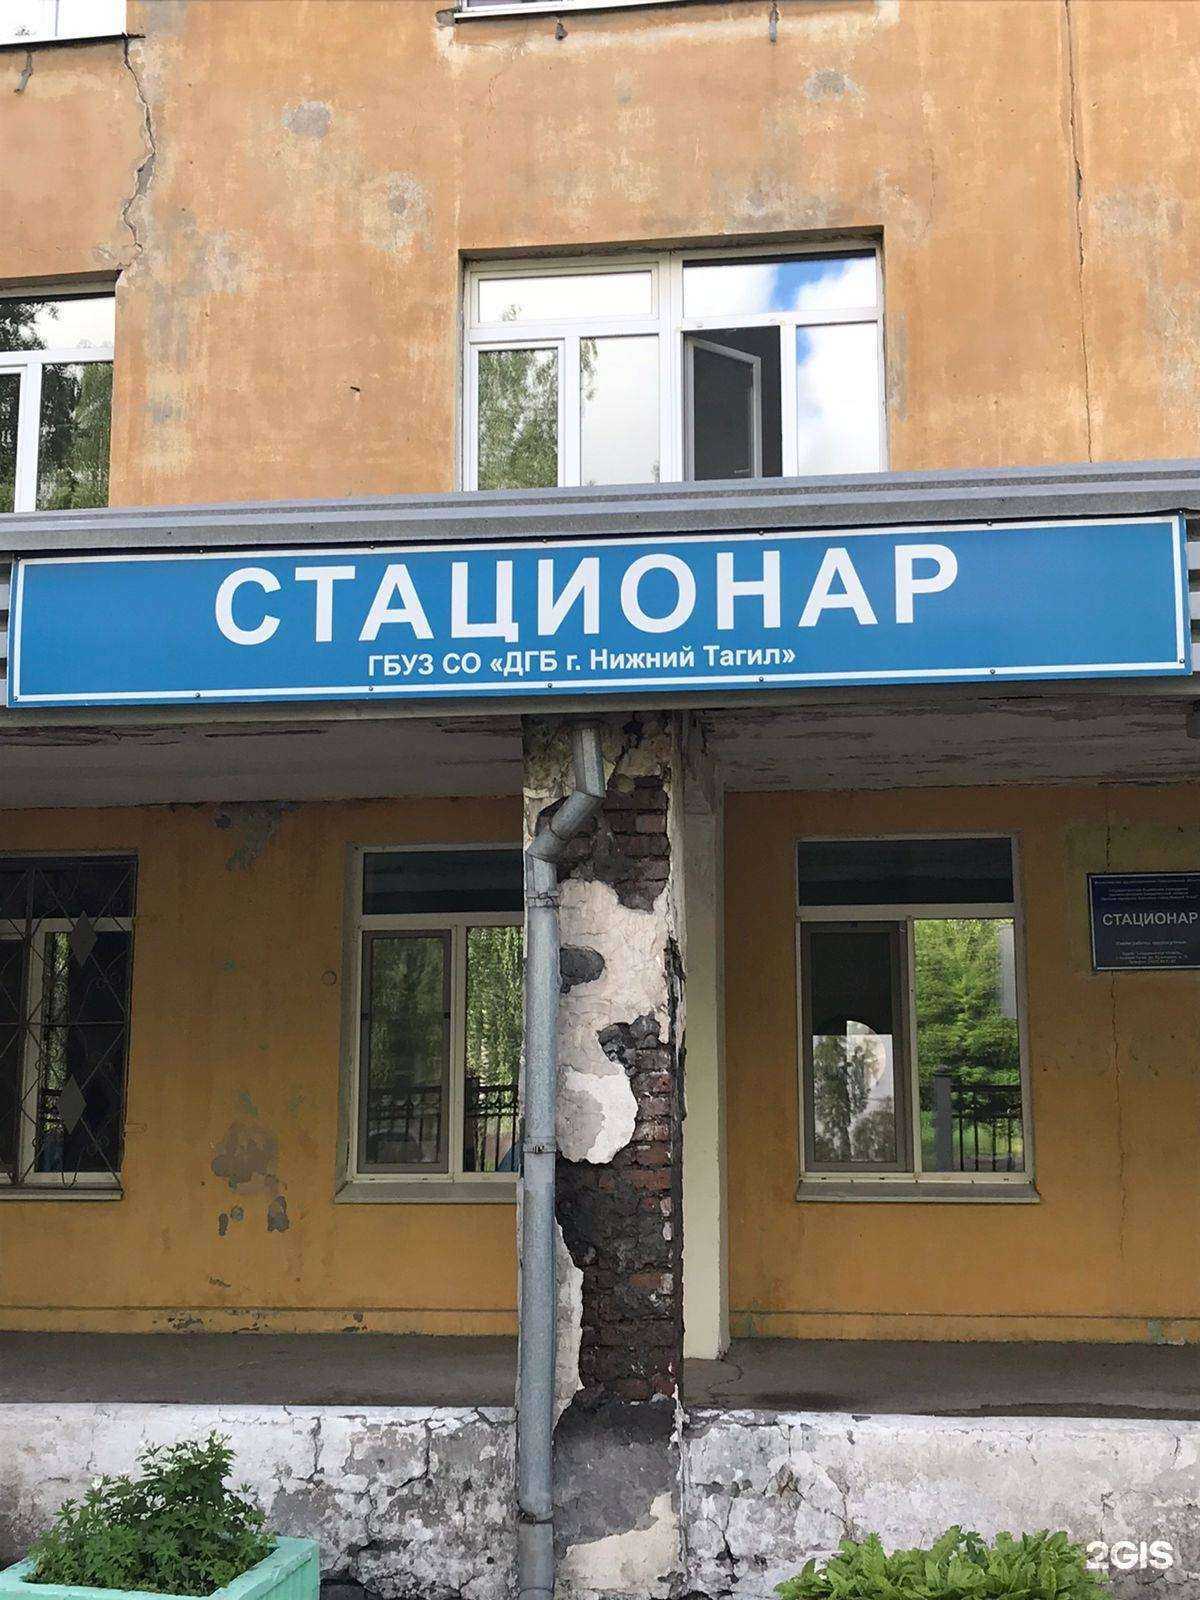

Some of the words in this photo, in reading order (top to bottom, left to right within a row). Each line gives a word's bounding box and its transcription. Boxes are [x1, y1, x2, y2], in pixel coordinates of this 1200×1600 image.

[214, 543, 959, 646] СТАЦИОНАР
[368, 653, 434, 677] ГБУЗ
[442, 652, 482, 675] СО
[490, 650, 558, 677] «ДГБ
[566, 654, 581, 672] г.
[589, 645, 695, 671] Нижний
[702, 645, 796, 667] Тагил»
[1102, 911, 1199, 928] СТАЦИОНАР
